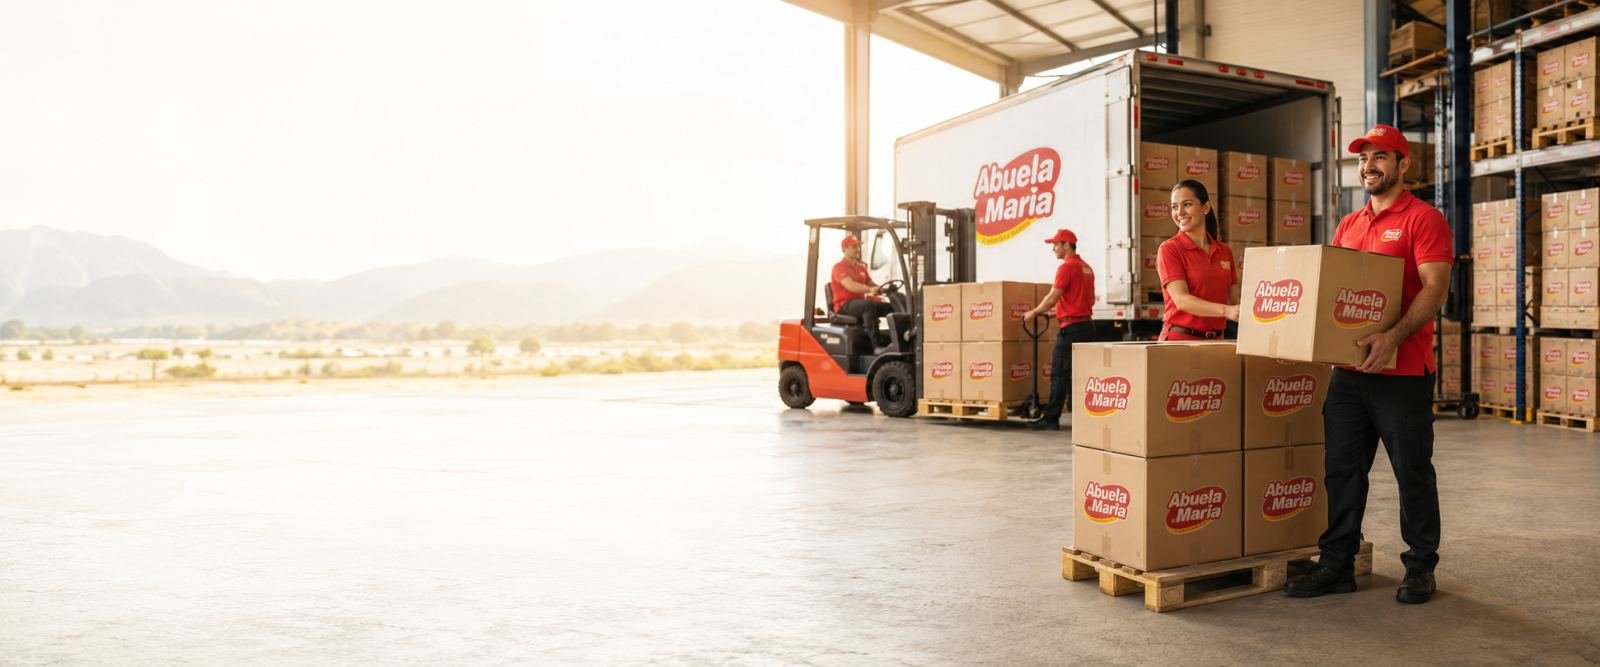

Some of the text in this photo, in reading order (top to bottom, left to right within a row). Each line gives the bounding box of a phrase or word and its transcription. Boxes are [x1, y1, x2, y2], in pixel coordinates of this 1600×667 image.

[975, 154, 1054, 197] Abuela
[984, 187, 1053, 224] Maria
[1255, 282, 1299, 297] Abuela
[1261, 297, 1298, 312] Maria
[1336, 289, 1383, 307] Abuela
[1342, 304, 1382, 321] Maria
[1086, 379, 1127, 394] Abuela
[1168, 381, 1222, 397] Abuela
[1265, 378, 1313, 393] Abuela
[1091, 393, 1126, 409] Maria
[1176, 396, 1221, 412] Maria
[1272, 392, 1312, 406] Maria
[1086, 483, 1127, 504] Abuela
[1265, 480, 1313, 497] Abuela
[1168, 489, 1222, 508] Abuela
[1272, 494, 1312, 510] Maria
[1091, 498, 1126, 518] Maria
[1175, 504, 1221, 523] Maria
